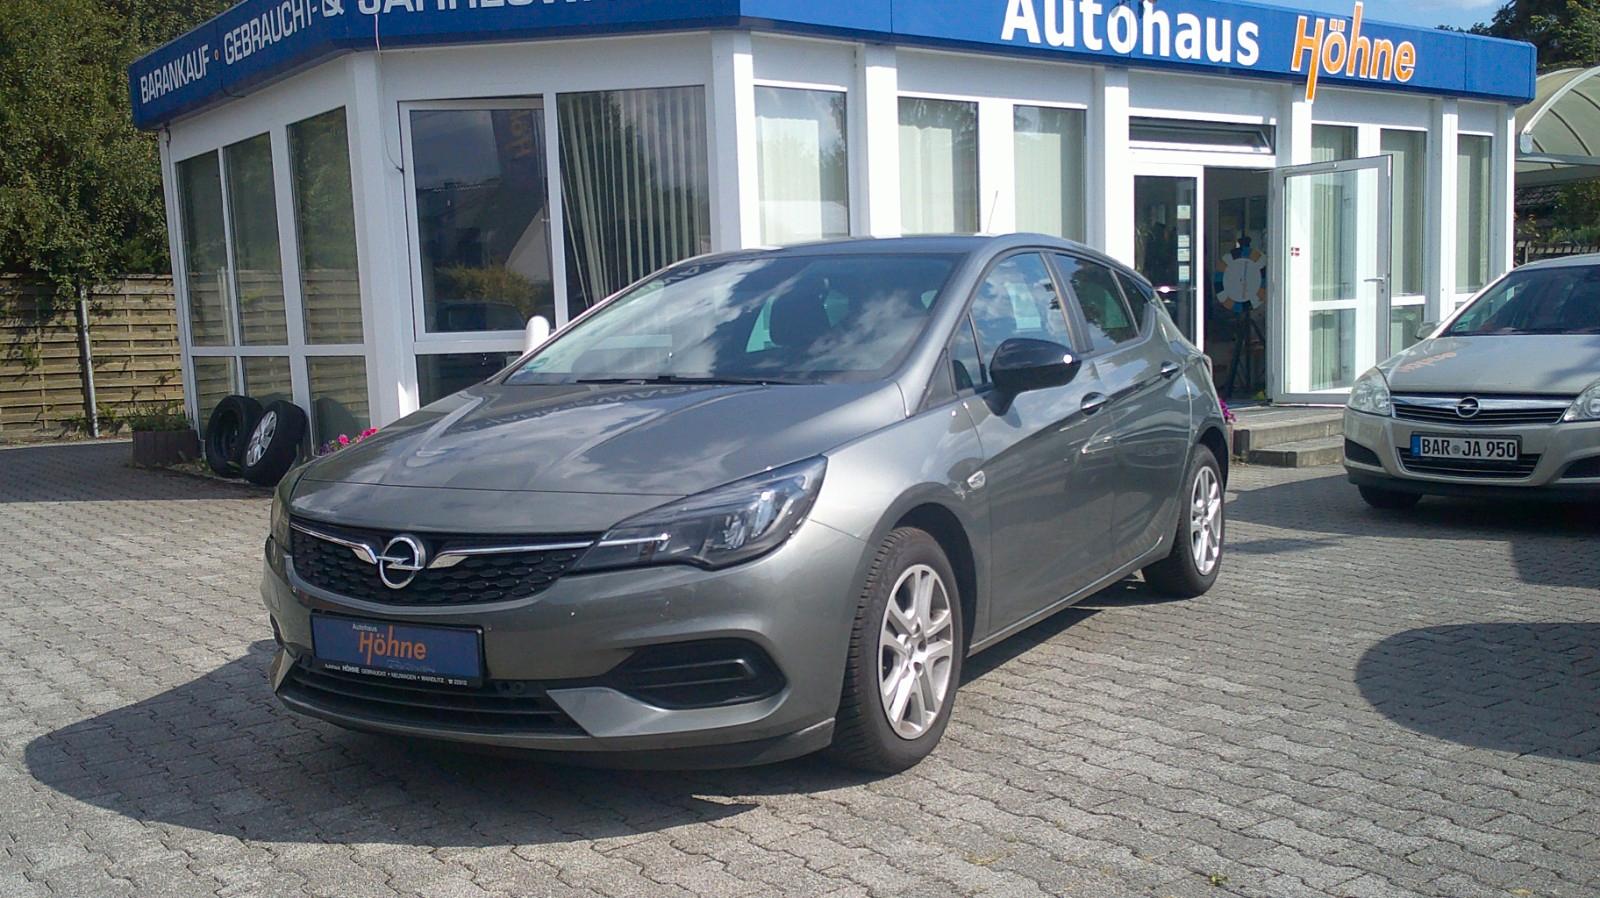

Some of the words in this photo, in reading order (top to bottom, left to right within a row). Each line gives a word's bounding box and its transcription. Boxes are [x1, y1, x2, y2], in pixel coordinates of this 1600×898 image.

[140, 44, 209, 104] BARANKAUF
[1000, 0, 1260, 67] Autohaus
[1291, 1, 1416, 104] Höhne
[1422, 438, 1451, 456] BAR
[1462, 440, 1482, 457] JA
[1486, 441, 1516, 458] 950
[359, 624, 427, 666] Höhne
